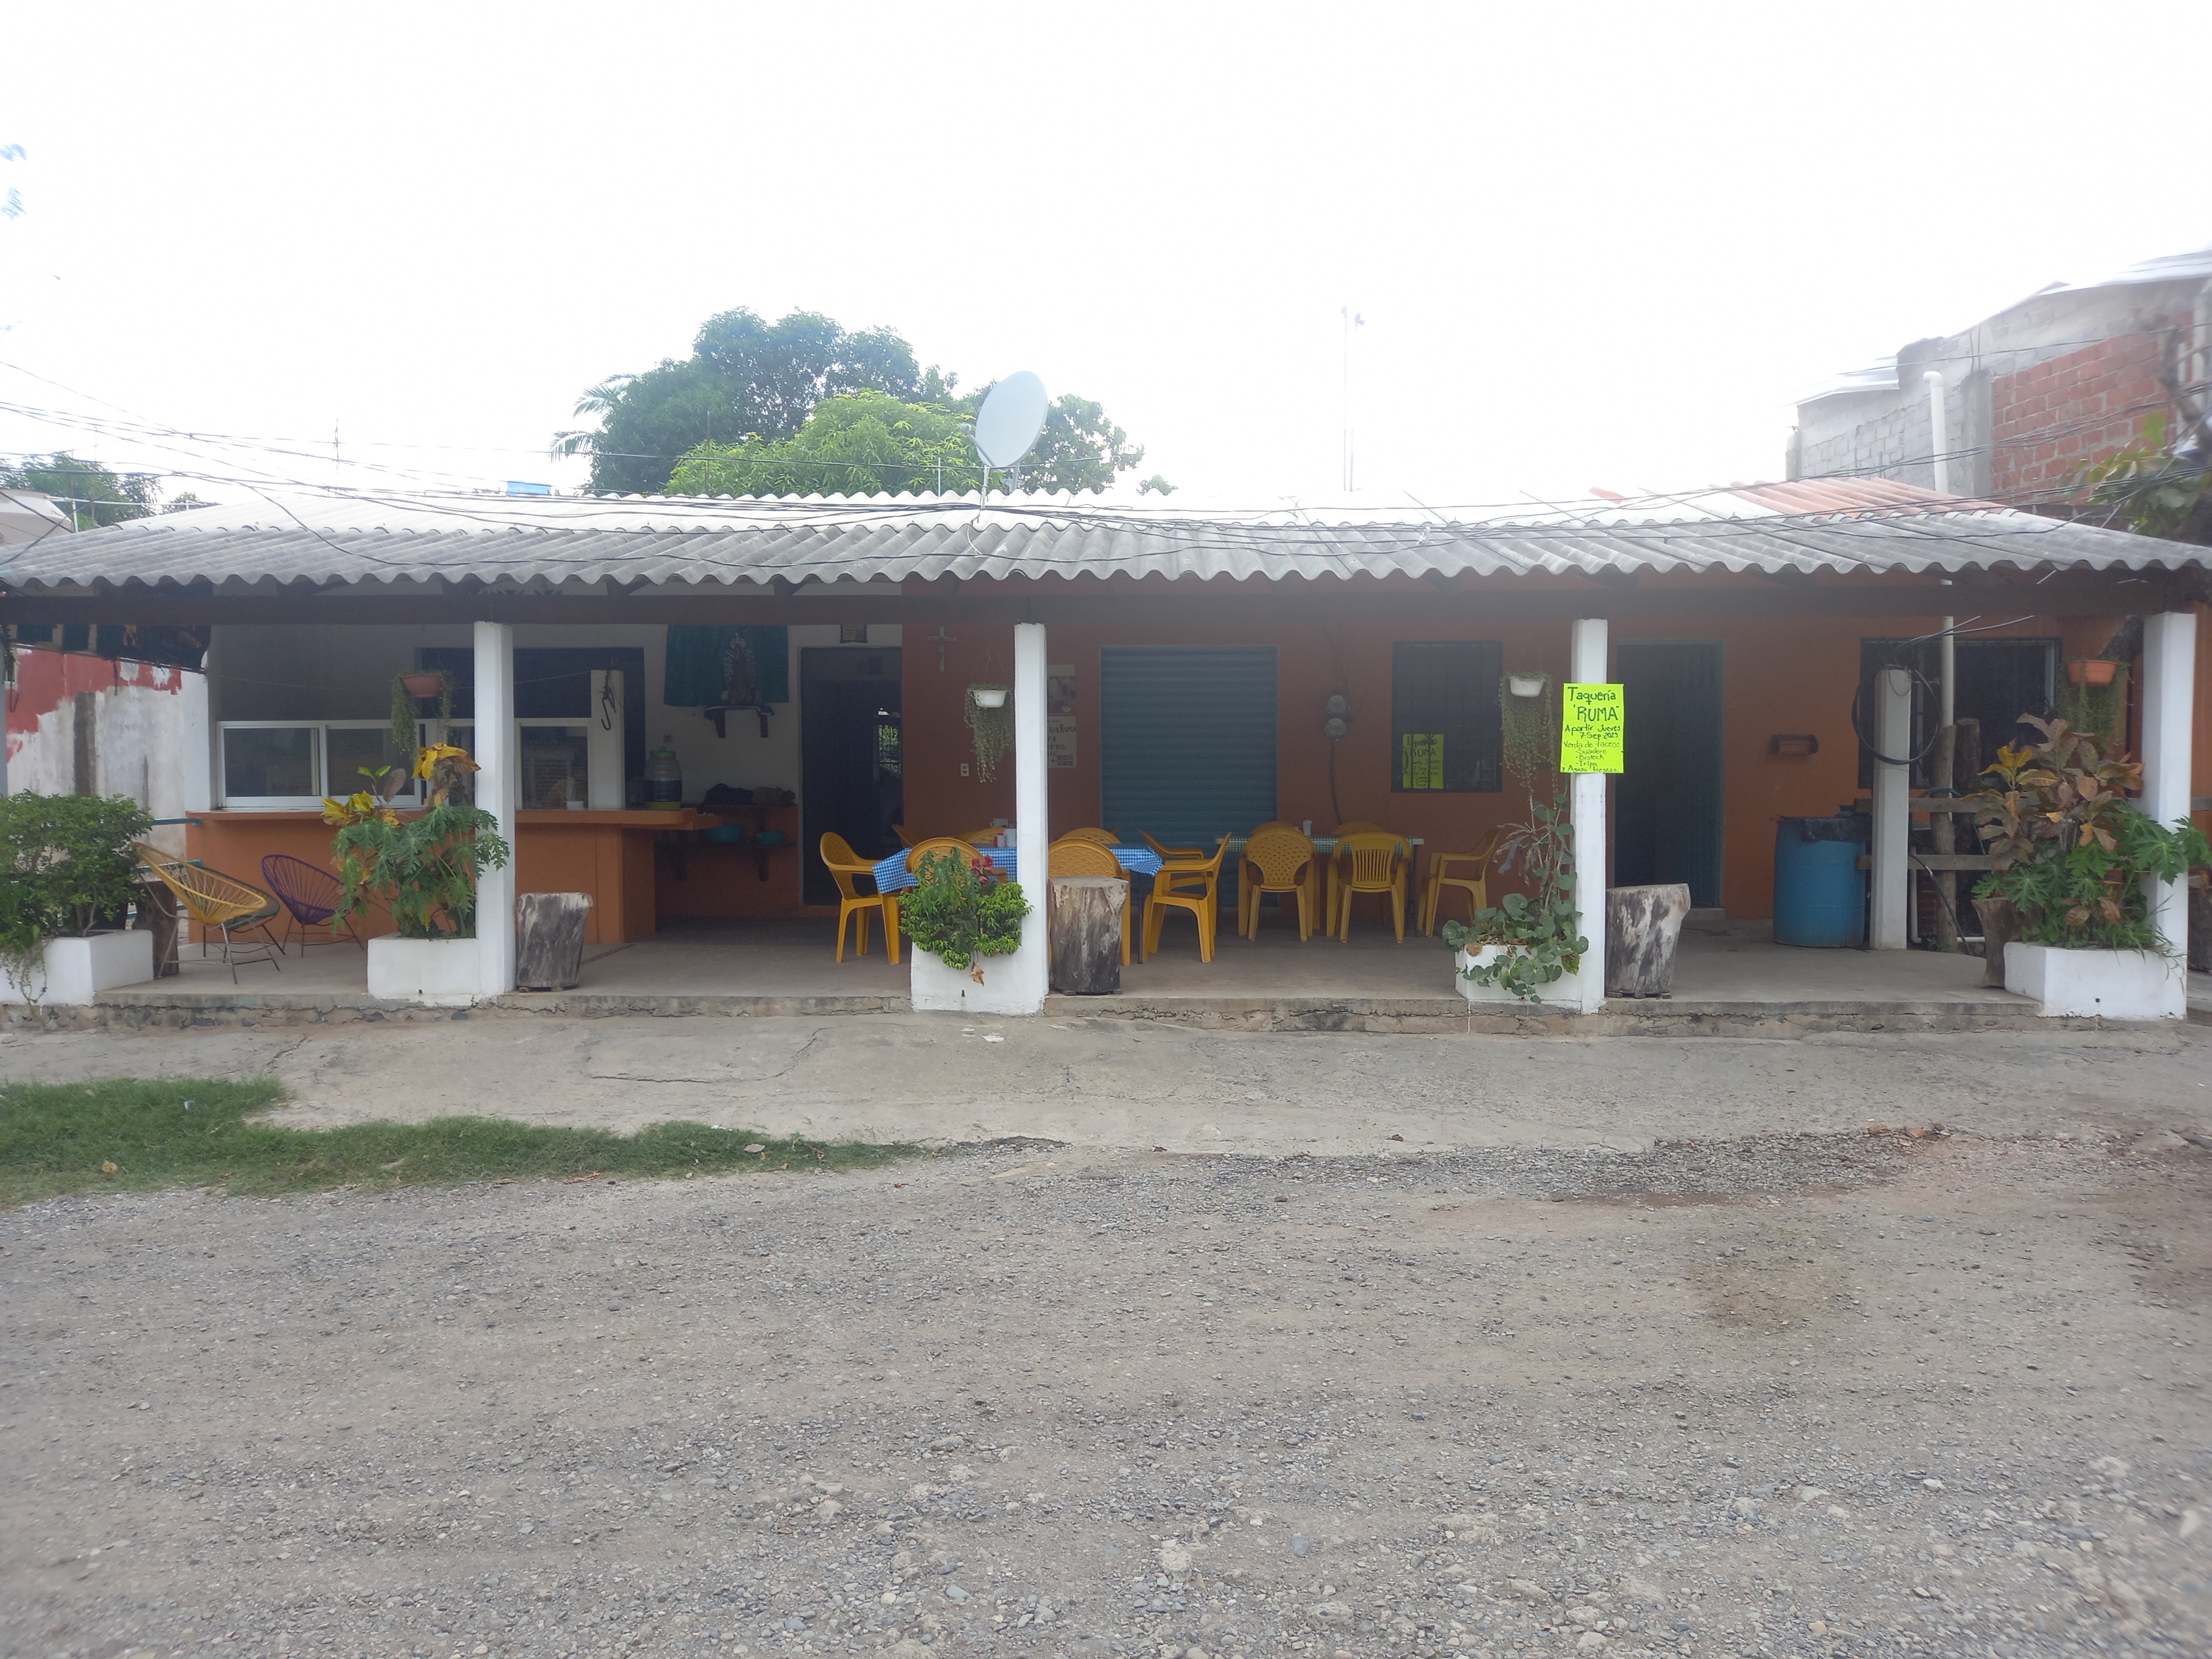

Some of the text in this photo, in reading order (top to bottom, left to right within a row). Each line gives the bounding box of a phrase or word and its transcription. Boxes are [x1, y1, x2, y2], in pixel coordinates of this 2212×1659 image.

[1567, 687, 1616, 705] Taquería
[1572, 723, 1593, 735] partir
[1598, 724, 1620, 732] Jueves
